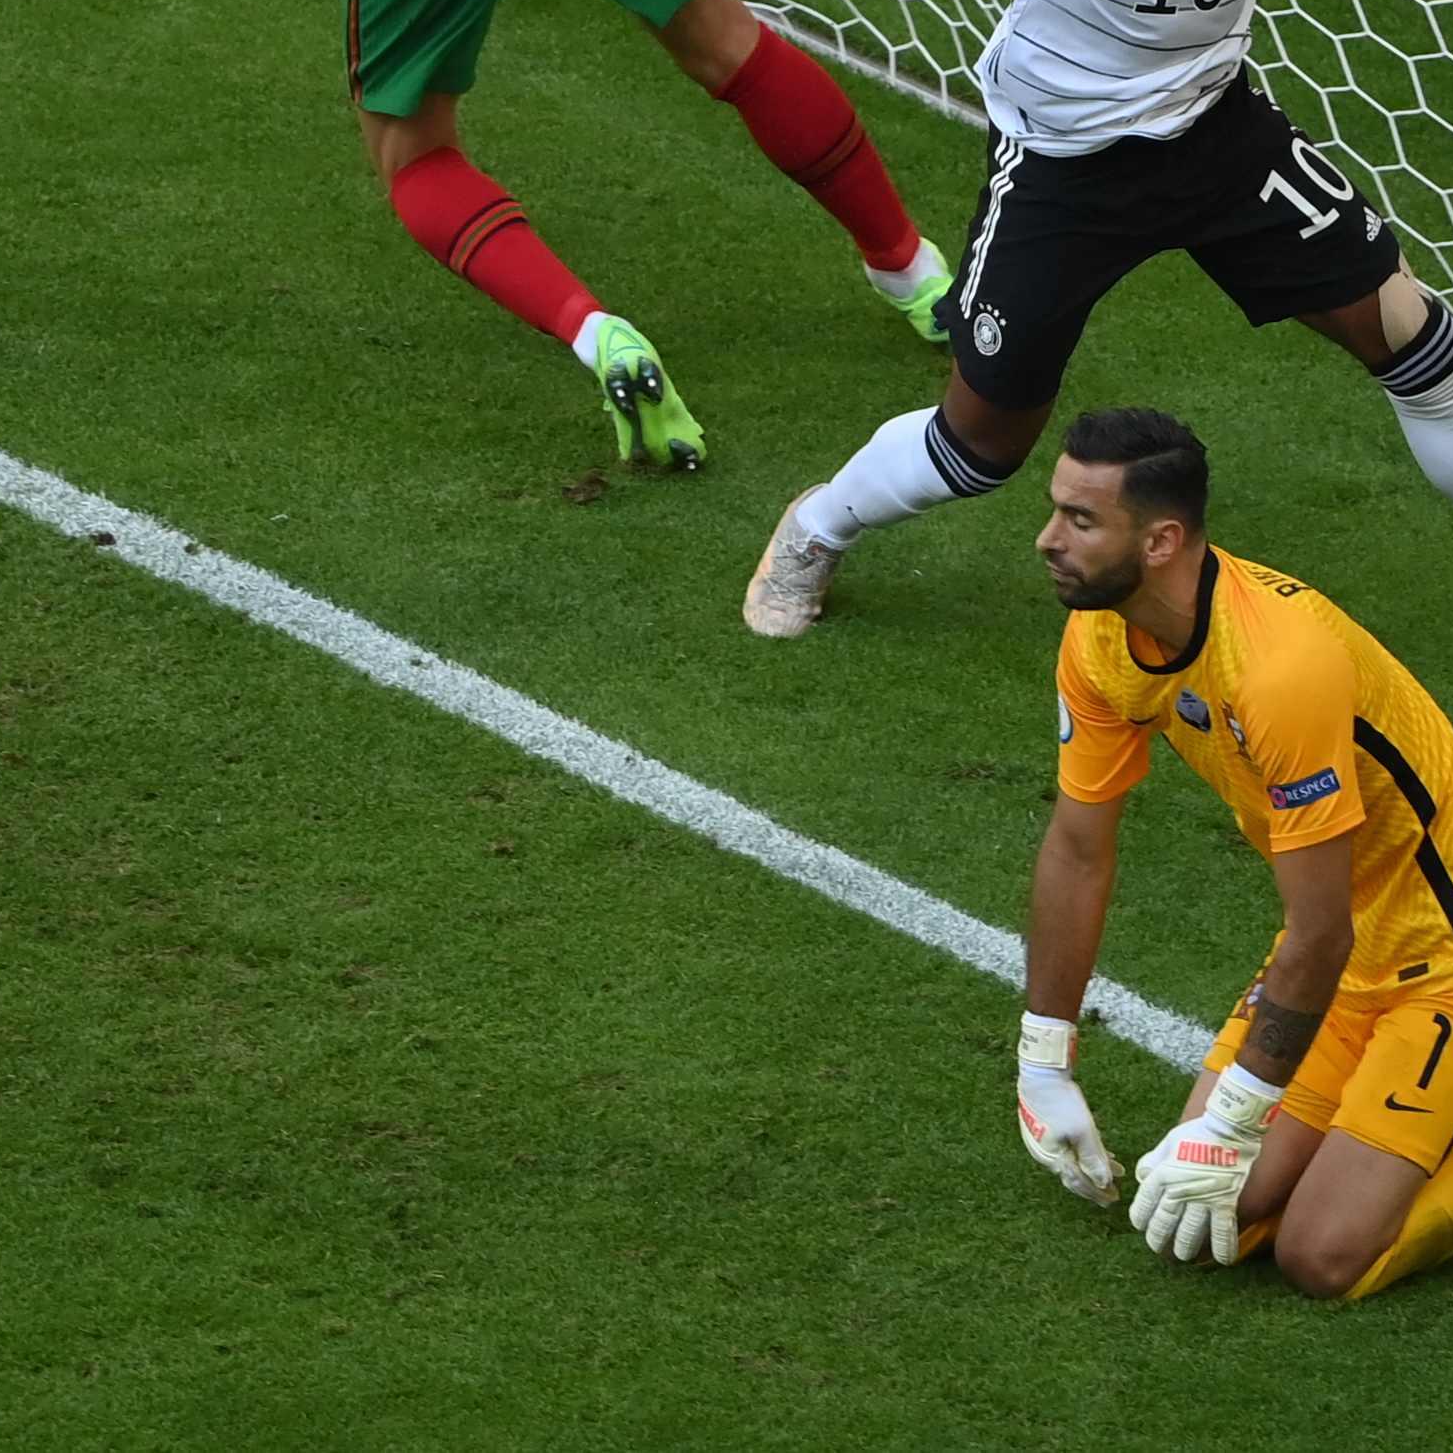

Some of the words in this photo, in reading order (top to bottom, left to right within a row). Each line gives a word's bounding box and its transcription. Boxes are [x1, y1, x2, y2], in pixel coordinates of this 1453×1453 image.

[1258, 136, 1355, 240] 10
[1284, 773, 1337, 802] RESPECT
[1417, 1012, 1452, 1091] 1
